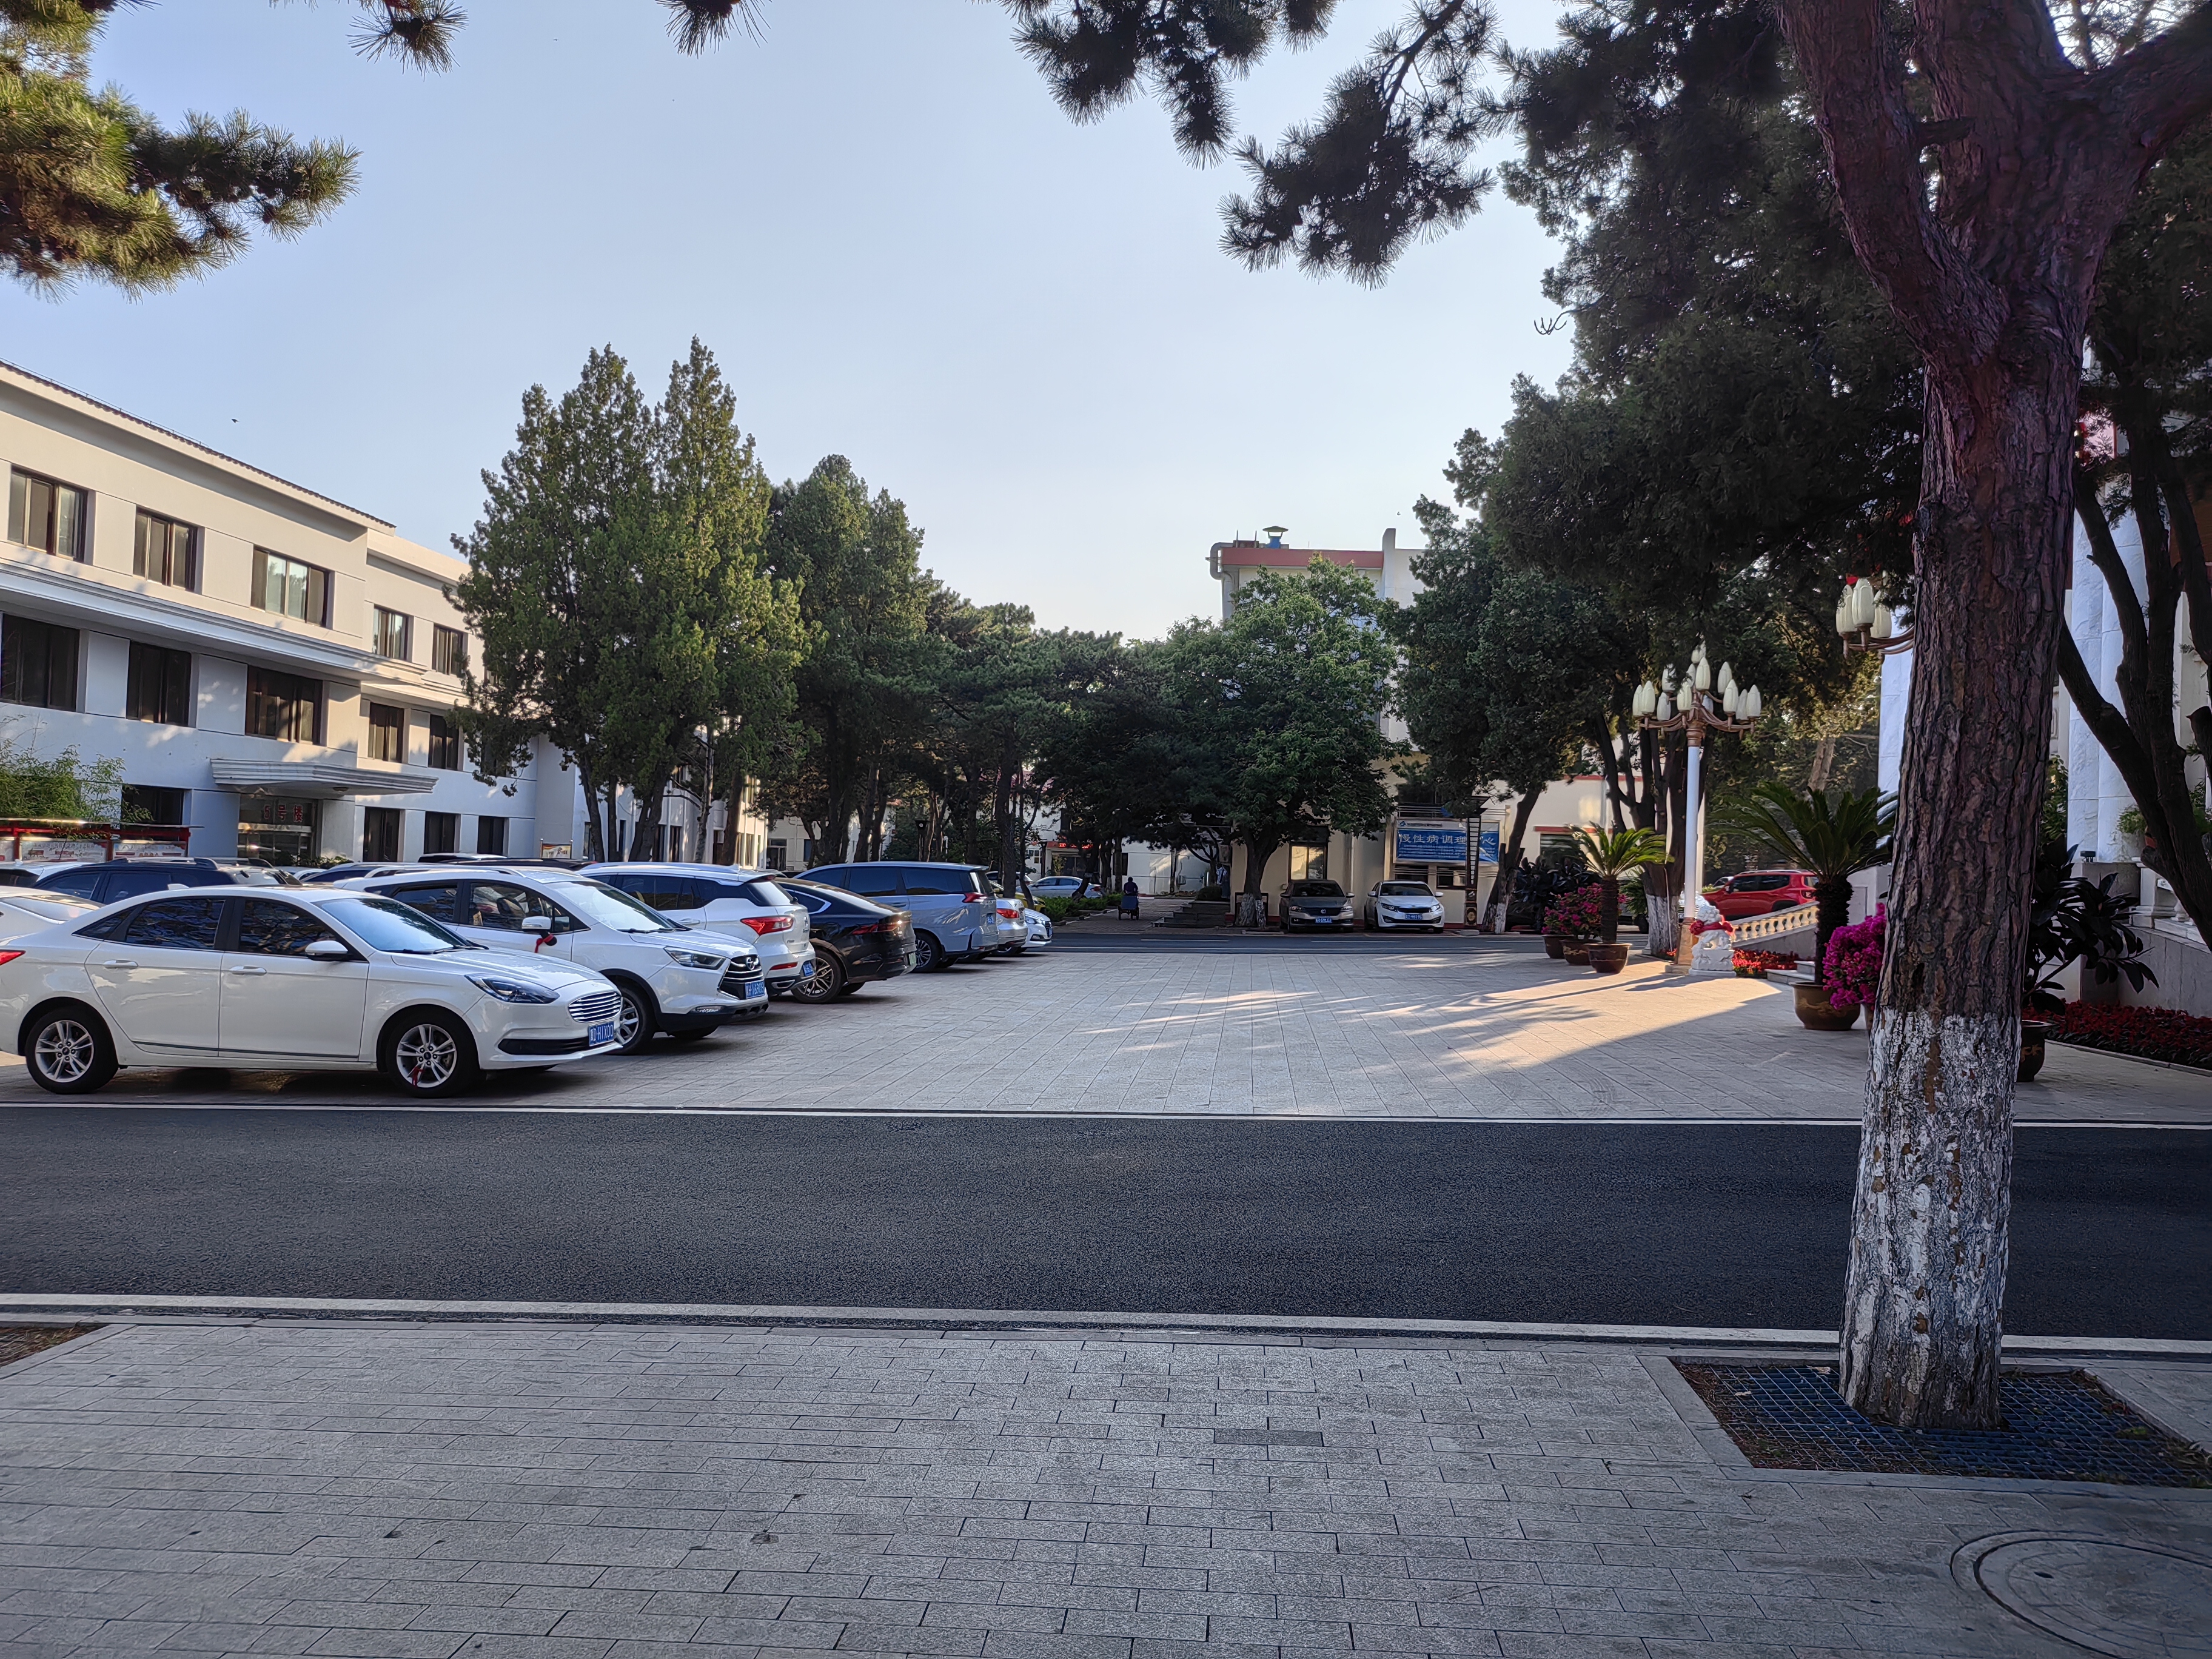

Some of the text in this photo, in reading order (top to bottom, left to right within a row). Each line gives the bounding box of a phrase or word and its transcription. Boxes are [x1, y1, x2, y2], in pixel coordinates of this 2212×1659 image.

[263, 804, 303, 822] 5号楼
[1399, 833, 1496, 845] 慢性病调理心
